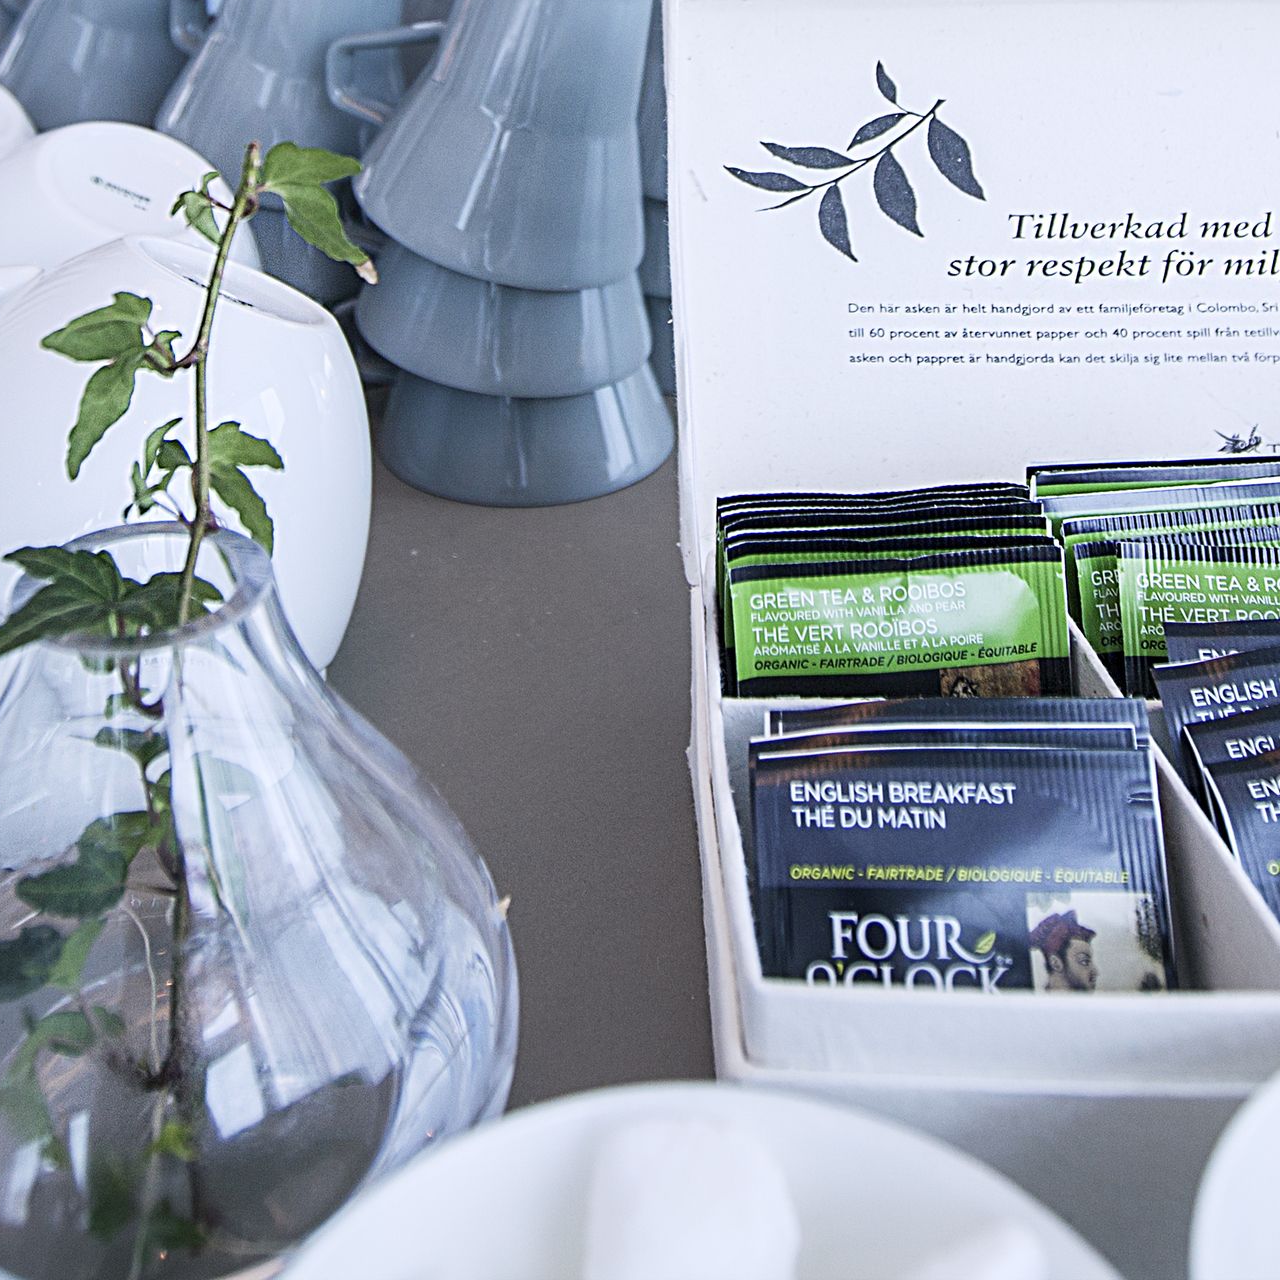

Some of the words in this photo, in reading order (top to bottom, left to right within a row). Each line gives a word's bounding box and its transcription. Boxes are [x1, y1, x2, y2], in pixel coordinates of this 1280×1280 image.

[1007, 212, 1189, 240] Tillverkad
[1200, 211, 1274, 239] med
[947, 253, 1016, 278] stor
[1026, 250, 1152, 285] respekt
[1161, 249, 1214, 284] för
[848, 303, 875, 314] Den
[879, 303, 901, 314] här
[904, 303, 941, 314] asken
[945, 304, 959, 314] är
[962, 303, 986, 314] helt
[990, 303, 1055, 317] handgjord
[1058, 306, 1072, 314] av
[1076, 304, 1095, 314] ett
[1098, 302, 1185, 316] familjeföretag
[1196, 302, 1260, 314] Colombo,
[1261, 302, 1279, 313] Sri
[848, 328, 865, 338] till
[869, 328, 885, 339] 60
[889, 329, 940, 341] procent
[944, 330, 958, 338] av
[962, 327, 1032, 339] återvunnet
[1036, 329, 1080, 342] papper
[1084, 328, 1108, 338] och
[1112, 328, 1128, 338] 40
[1132, 328, 1183, 340] procent
[1186, 327, 1211, 340] spill
[1215, 326, 1240, 337] från
[849, 353, 885, 364] asken
[888, 353, 912, 364] och
[916, 354, 965, 366] pappret
[969, 353, 982, 363] är
[985, 353, 1055, 366] handgjorda
[1059, 353, 1081, 363] kan
[1085, 353, 1106, 363] det
[1109, 353, 1140, 365] skilja
[1143, 354, 1161, 366] sig
[1164, 352, 1183, 363] lite
[1187, 352, 1228, 363] mellan
[1231, 352, 1250, 362] två
[1137, 572, 1201, 591] GREEN
[1204, 575, 1243, 592] TEA
[1246, 577, 1261, 593] &
[749, 591, 816, 611] GREEN
[821, 587, 858, 606] TEA
[862, 587, 876, 604] &
[880, 581, 966, 603] ROOIBOS
[1136, 591, 1207, 604] FLAVOURED
[1210, 593, 1240, 604] WITH
[750, 610, 821, 624] FLAVOURED
[823, 608, 854, 620] WITH
[856, 605, 905, 618] VANILLA
[907, 602, 933, 615] AND
[935, 599, 966, 612] PEAR
[1138, 604, 1176, 623] THÉ
[1180, 609, 1230, 623] VERT
[752, 622, 790, 644] THÉ
[794, 623, 845, 643] VERT
[850, 617, 938, 640] ROOÏBOS
[754, 658, 809, 671] ORGANIC
[819, 656, 885, 669] FAIRTRADE
[896, 650, 969, 665] BIOLOGIQUE
[977, 642, 1038, 659] ÉQUITABLE
[823, 640, 834, 655] À
[835, 642, 851, 654] LA
[853, 640, 901, 653] VANILLE
[903, 638, 920, 650] ET
[921, 635, 932, 649] À
[933, 637, 948, 648] LA
[949, 633, 984, 646] POIRE
[1189, 679, 1278, 707] ENGLISH
[790, 780, 885, 805] ENGLISH
[888, 781, 1017, 805] BREAKFAST
[791, 803, 836, 829] THÉ
[840, 806, 873, 829] DU
[877, 806, 947, 830] MATIN
[789, 865, 855, 881] ORGANIC
[866, 867, 945, 882] FAIRTRADE
[957, 868, 1043, 884] BIOLOGIQUE
[1054, 866, 1129, 884] ÉQUITABLE
[829, 910, 996, 964] FOUR
[806, 960, 1010, 992] O'CLOCK
